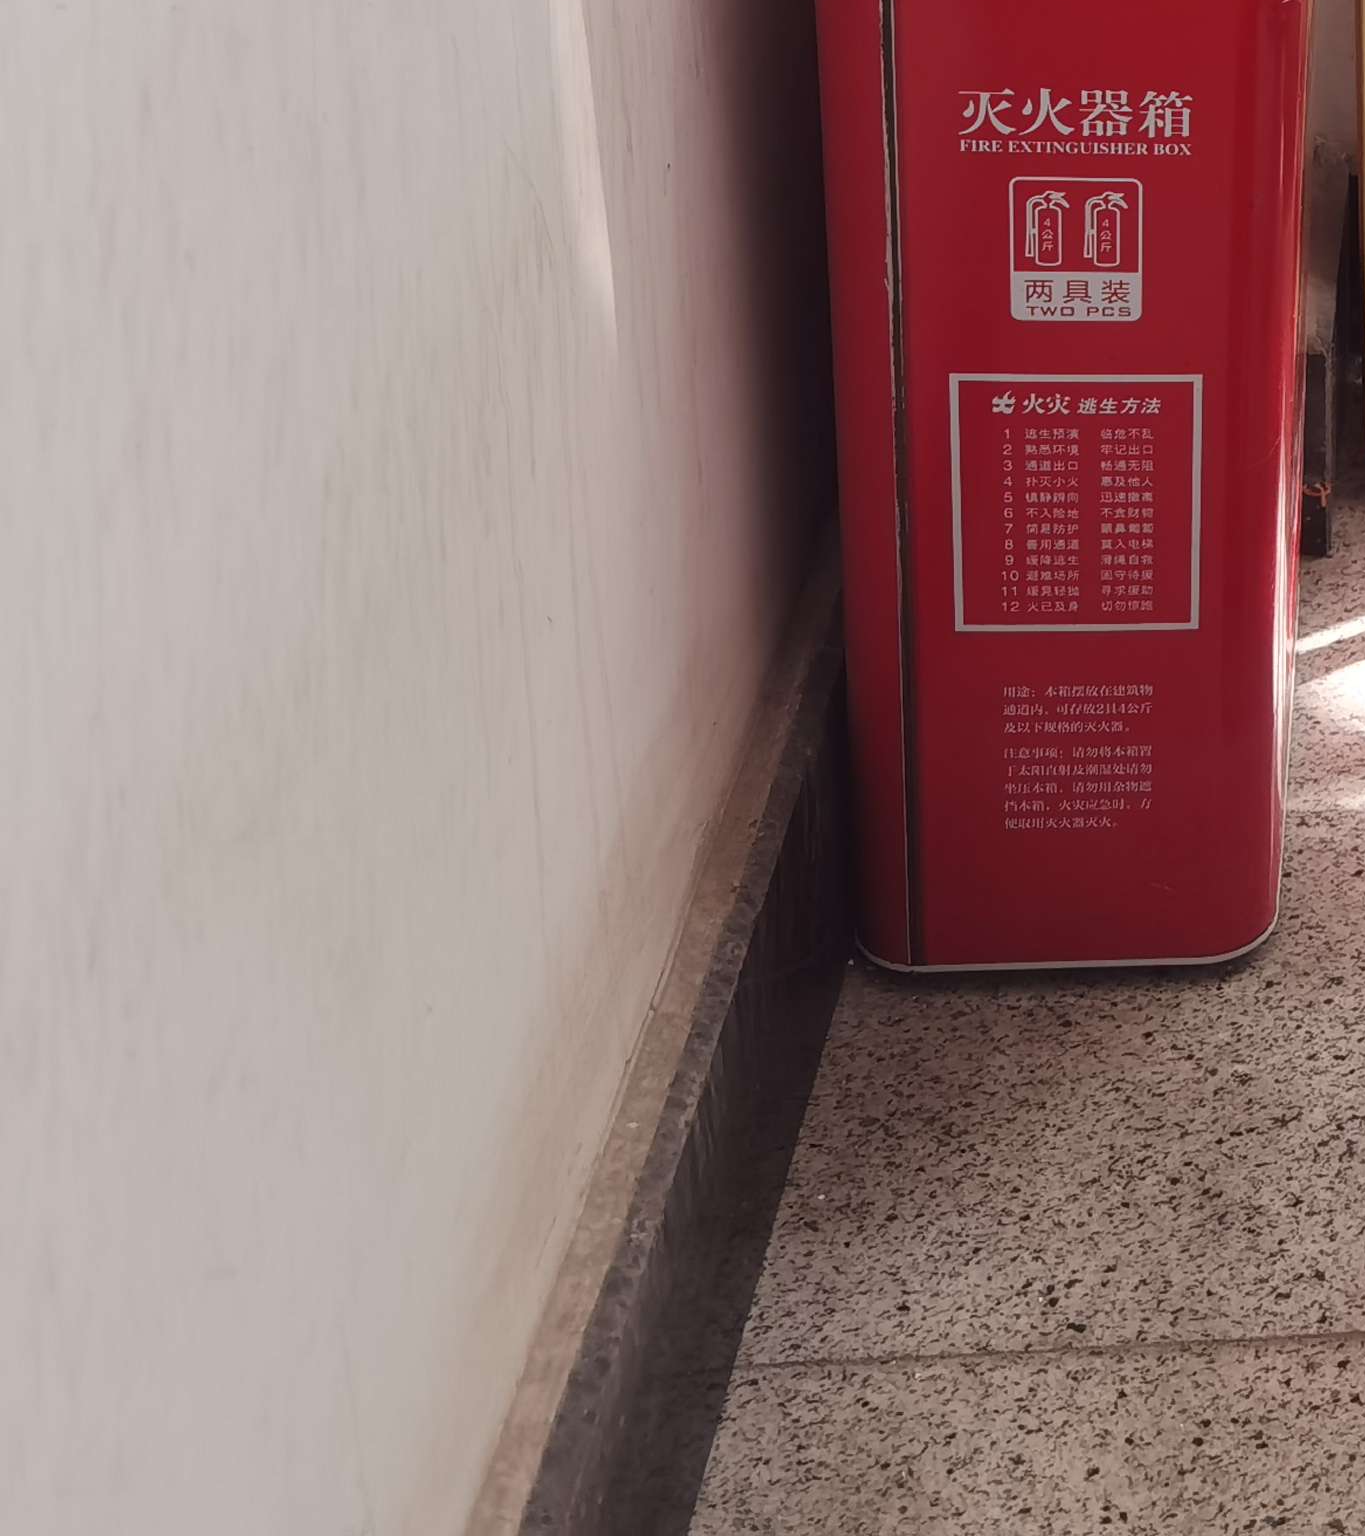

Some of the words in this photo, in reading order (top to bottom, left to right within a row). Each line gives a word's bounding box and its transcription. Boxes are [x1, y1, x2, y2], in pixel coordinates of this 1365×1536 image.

[959, 88, 1192, 138] 灭火器箱
[959, 139, 1003, 153] FIRE
[1008, 140, 1148, 156] EXTINGUISHER
[1153, 143, 1192, 156] BOX
[1042, 218, 1053, 251] 4公斤
[1100, 219, 1112, 252] 4公斤
[1024, 280, 1130, 304] 两具装
[1025, 305, 1075, 317] TWO
[1086, 306, 1132, 318] PCS
[1023, 393, 1070, 414] 火灾
[1076, 397, 1161, 415] 逃生方法
[1003, 428, 1010, 440] 1
[1100, 427, 1154, 440] 临危不乱
[1002, 443, 1013, 456] 2
[1100, 443, 1153, 456] 牢记出口
[1003, 459, 1013, 472] 3
[1024, 459, 1079, 472] 通道出口
[1100, 459, 1154, 472] 畅通无阻
[1003, 475, 1013, 487] 4
[1025, 475, 1079, 488] 扑灭小火
[1003, 491, 1014, 503] 5
[1003, 507, 1014, 519] 6
[1025, 507, 1080, 519] 不入险地
[1004, 522, 1014, 535] 7
[1004, 538, 1014, 551] 8
[1004, 554, 1015, 567] 9
[1001, 569, 1020, 582] 10
[1001, 585, 1017, 597] 11
[1001, 601, 1020, 613] 12
